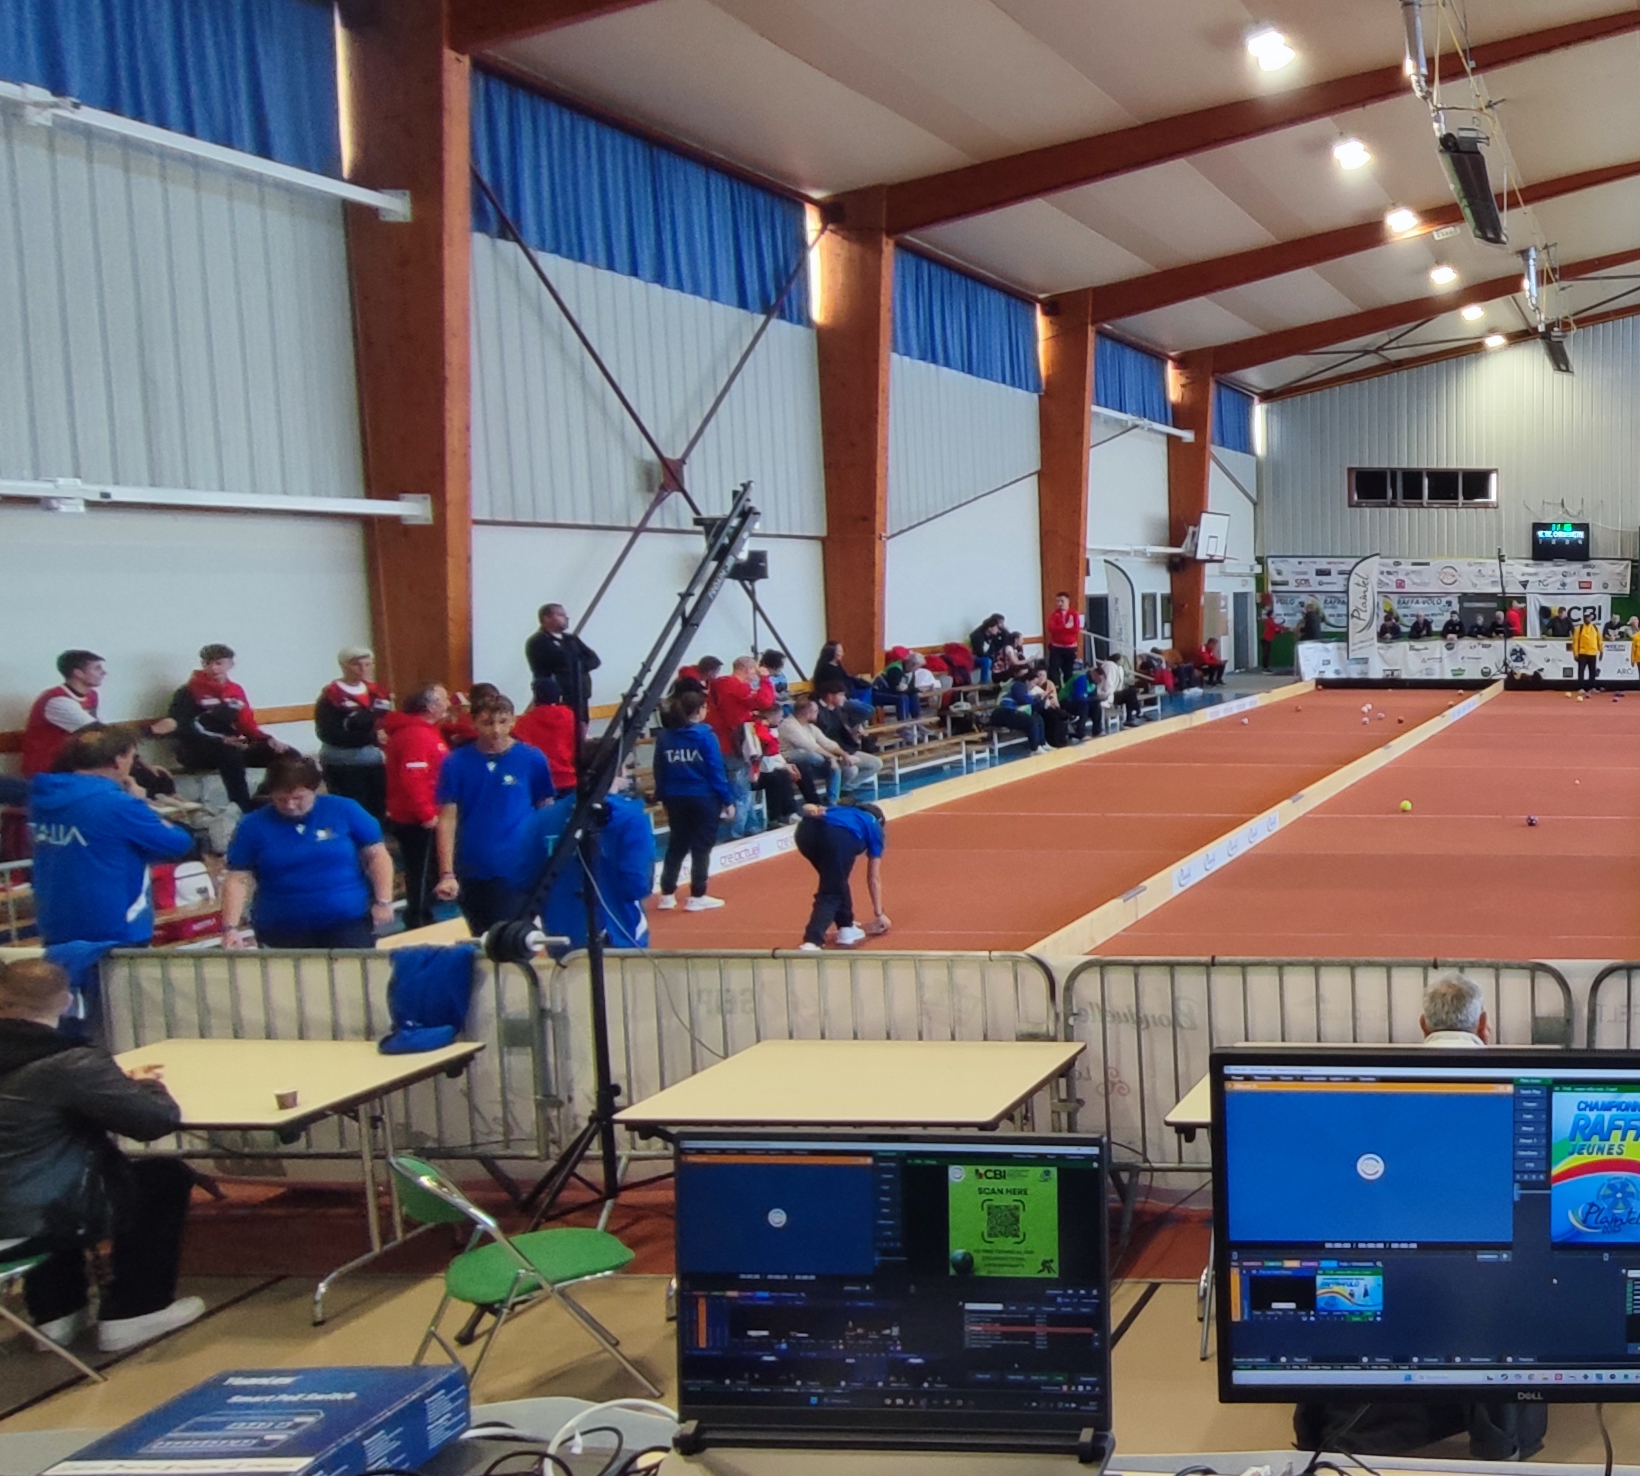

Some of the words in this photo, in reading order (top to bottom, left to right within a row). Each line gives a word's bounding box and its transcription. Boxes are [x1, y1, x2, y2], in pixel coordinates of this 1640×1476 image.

[1351, 572, 1370, 622] Plaintel
[1568, 1143, 1625, 1156] JEUNES
[984, 1169, 1007, 1180] CBI
[978, 1187, 1004, 1195] SCAN
[1006, 1187, 1028, 1196] HERE
[1517, 1391, 1544, 1400] DELL
